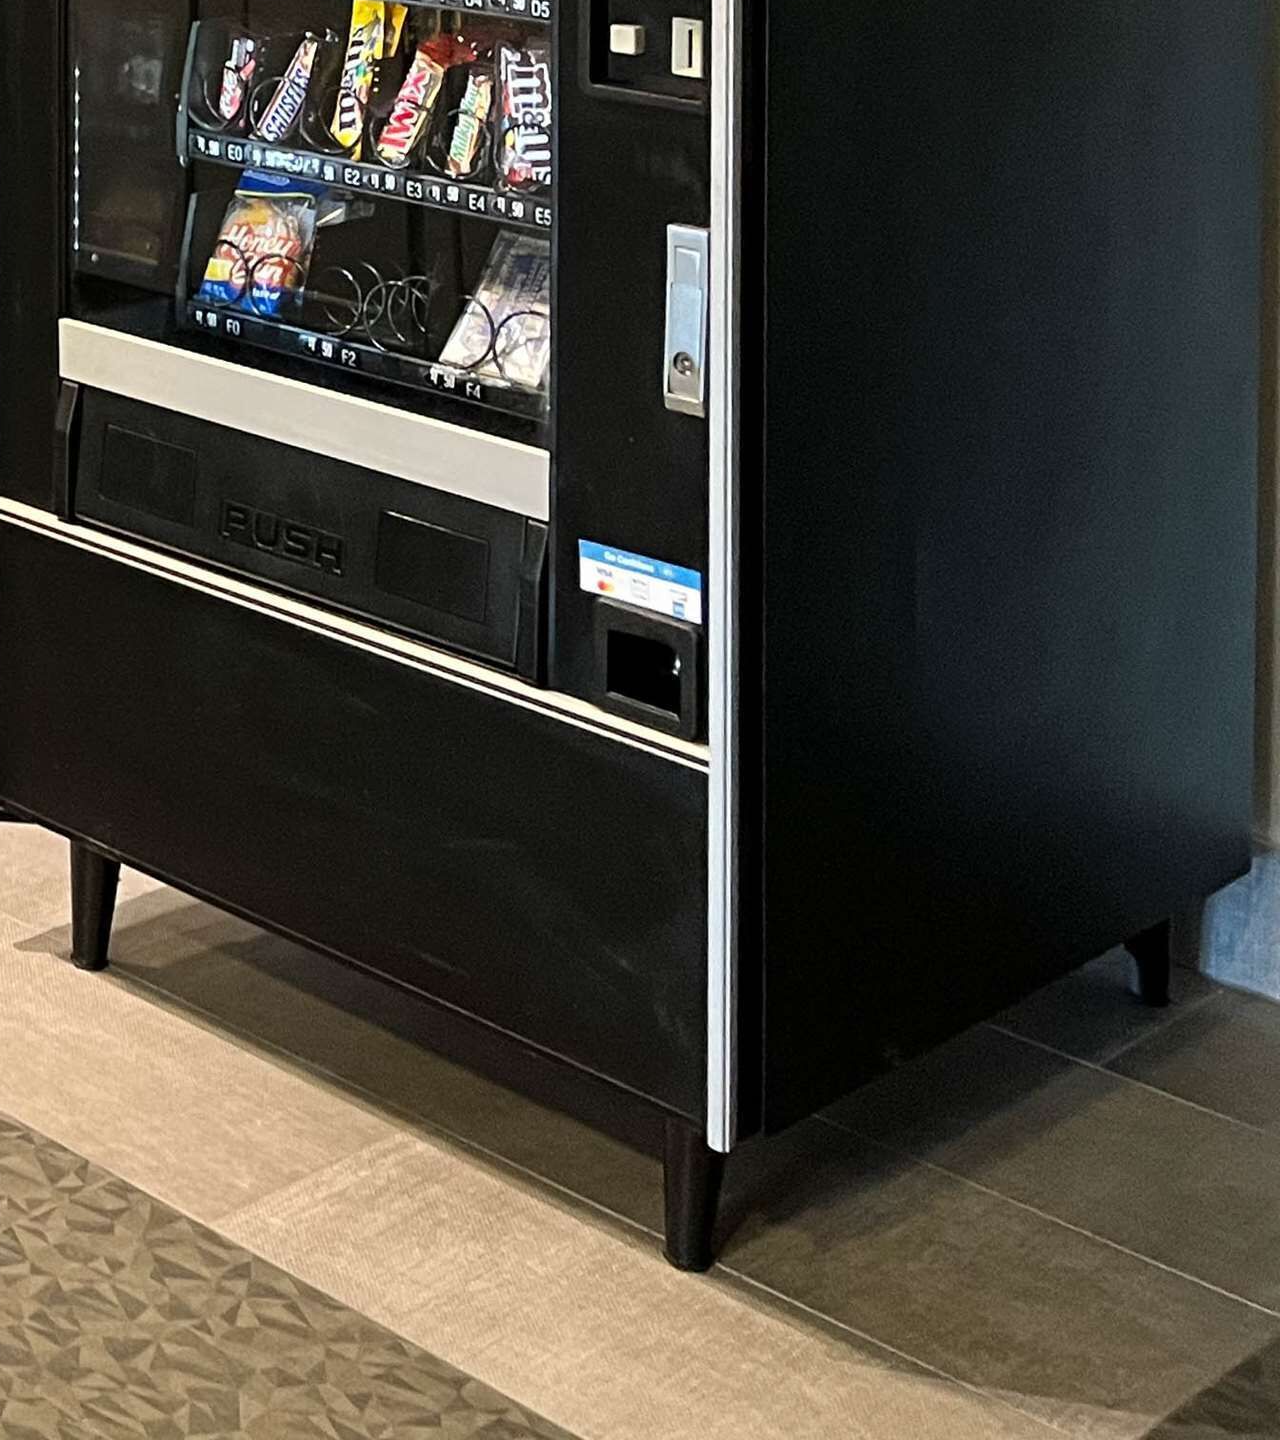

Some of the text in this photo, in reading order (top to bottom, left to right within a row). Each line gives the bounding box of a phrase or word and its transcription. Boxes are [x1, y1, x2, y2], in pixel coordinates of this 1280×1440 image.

[530, 0, 550, 18] D5
[227, 144, 243, 162] E0
[344, 168, 361, 185] E2
[406, 181, 423, 198] E3
[468, 194, 486, 211] E4
[535, 208, 552, 226] E5
[226, 319, 241, 336] F0
[341, 348, 357, 368] F2
[466, 382, 481, 400] F4
[221, 500, 344, 574] PUSH
